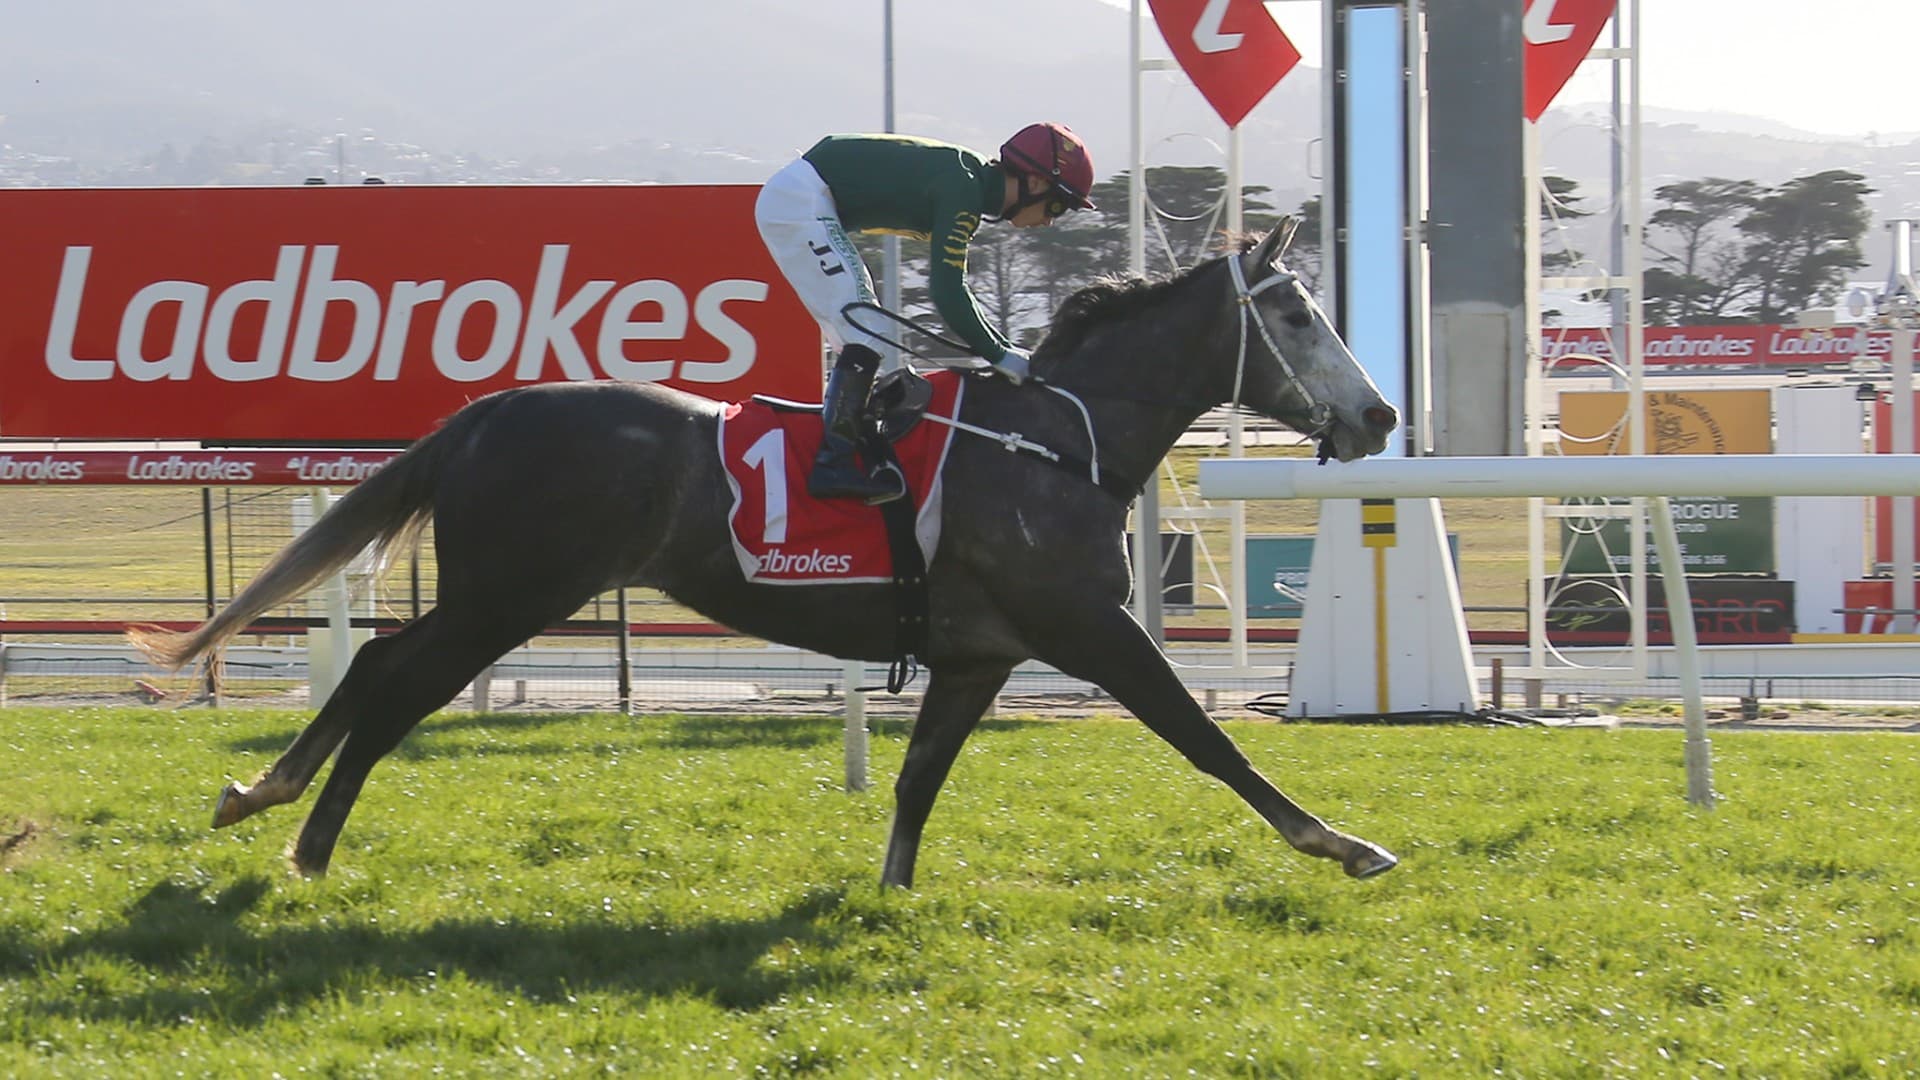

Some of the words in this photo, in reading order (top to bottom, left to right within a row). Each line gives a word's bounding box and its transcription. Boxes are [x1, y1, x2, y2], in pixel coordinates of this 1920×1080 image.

[45, 244, 768, 382] Ladbrokes
[1644, 333, 1755, 357] adbrokes
[1769, 332, 1893, 355] Ladbroes
[127, 455, 256, 480] Ladbrokes
[297, 455, 394, 480] Ladbro
[742, 428, 789, 544] 1
[1671, 503, 1740, 519] ROGUE
[757, 548, 853, 573] dbrokes
